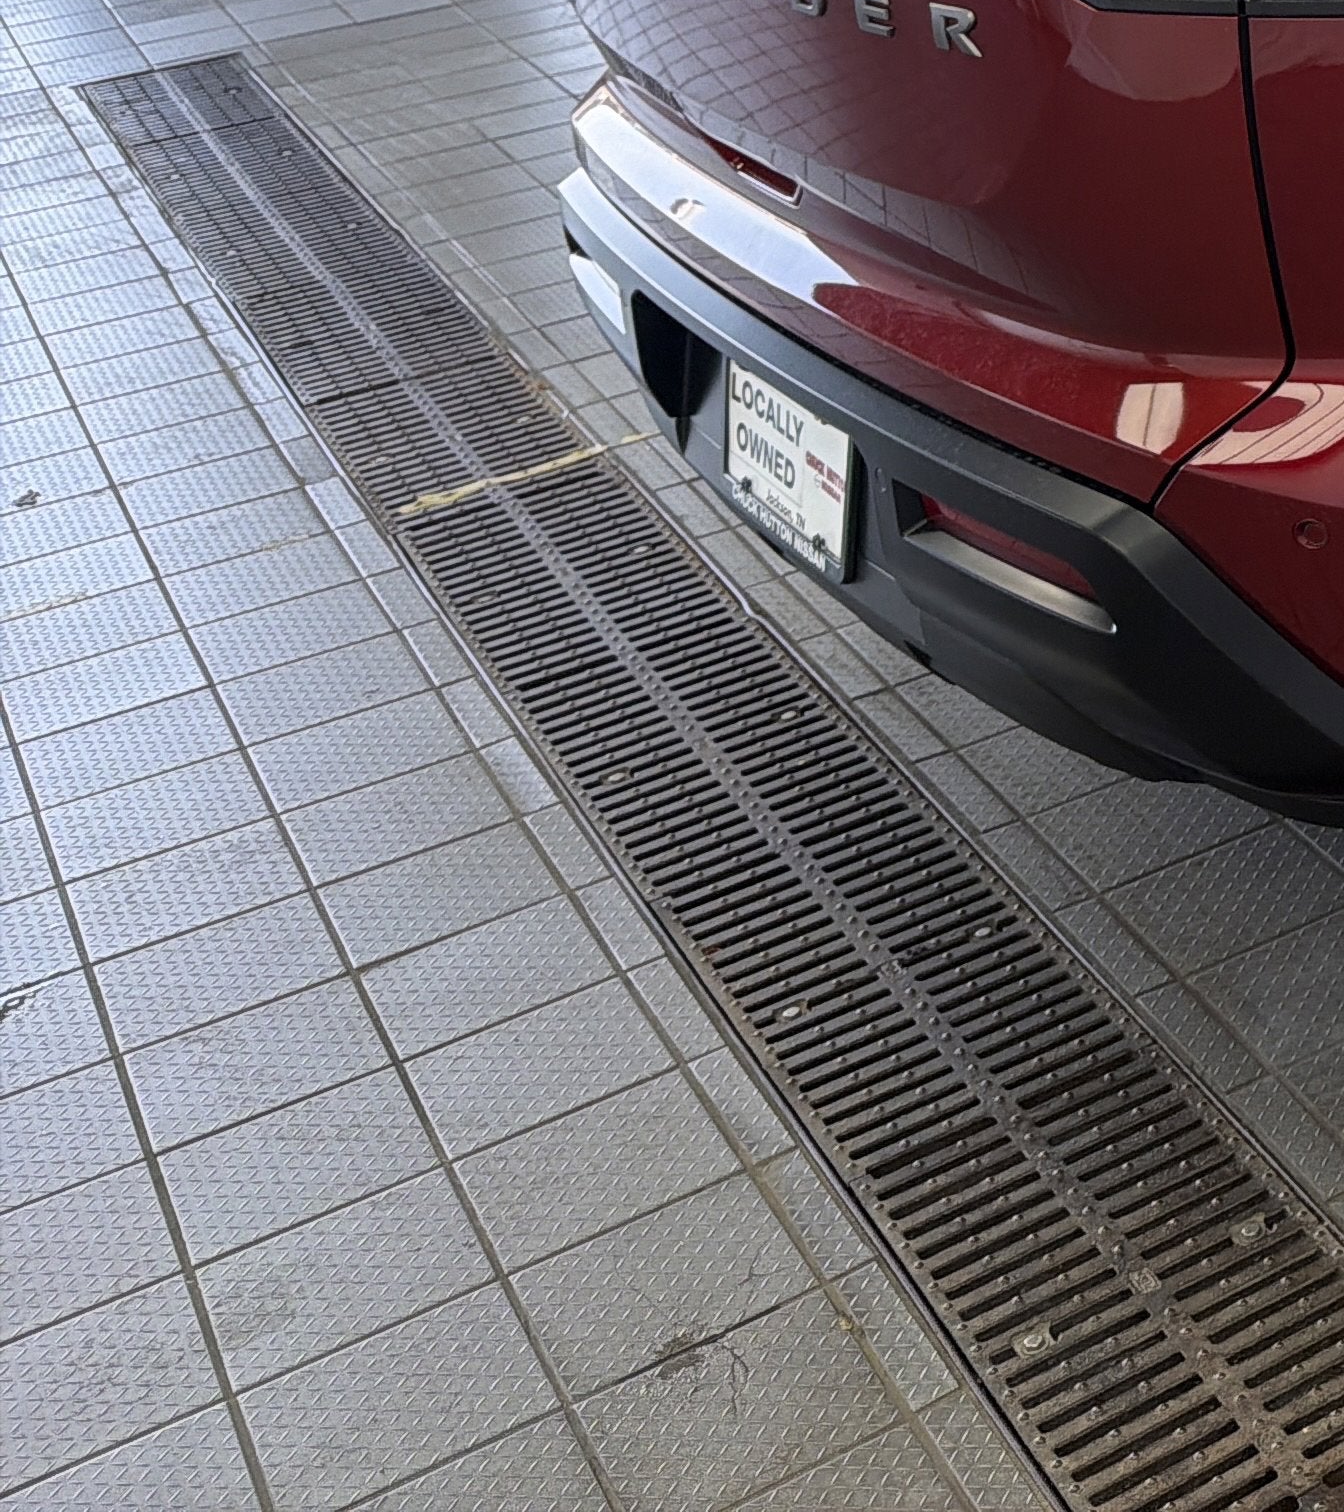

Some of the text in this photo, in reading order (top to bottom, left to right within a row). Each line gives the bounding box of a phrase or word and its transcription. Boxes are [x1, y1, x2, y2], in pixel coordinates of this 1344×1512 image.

[731, 372, 804, 447] LOCALLY
[737, 422, 796, 489] OWNED
[759, 506, 793, 545] HUTTON
